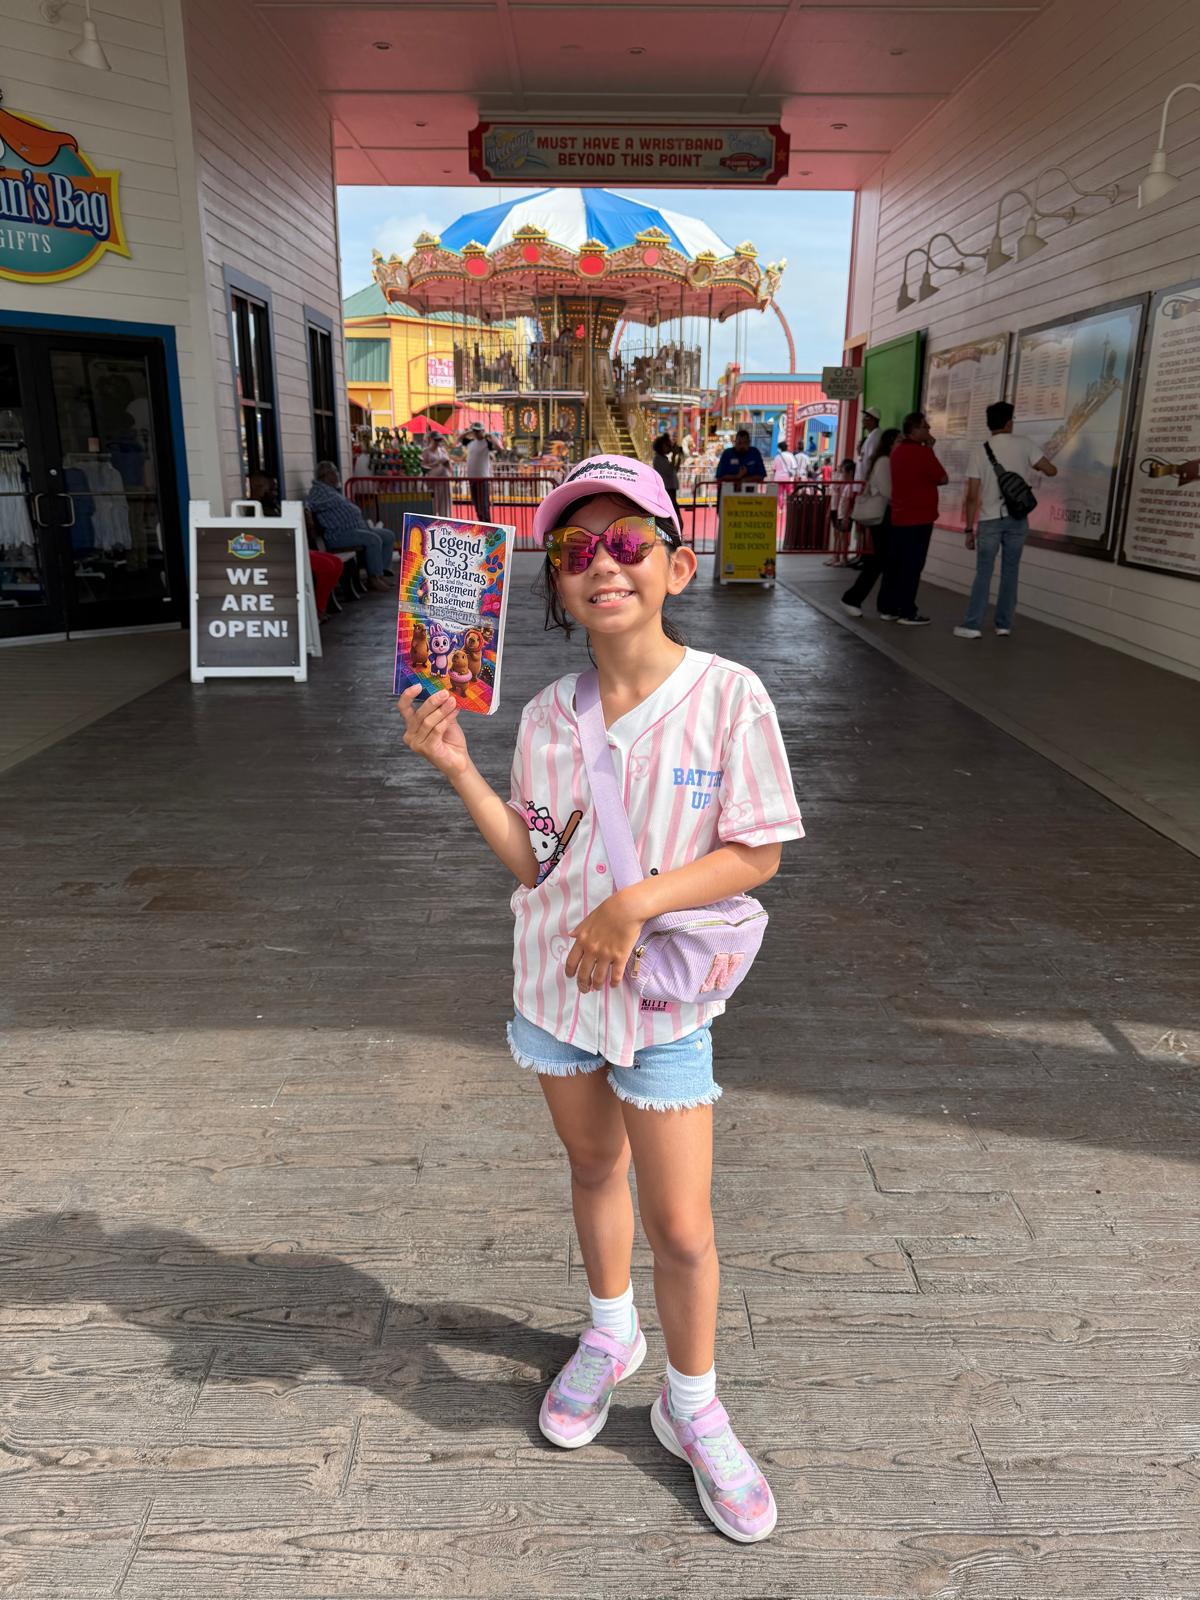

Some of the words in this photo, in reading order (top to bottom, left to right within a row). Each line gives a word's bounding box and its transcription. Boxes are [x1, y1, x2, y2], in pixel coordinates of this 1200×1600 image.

[536, 137, 577, 150] MUST
[583, 137, 620, 150] HAVE
[625, 137, 634, 150] A
[639, 138, 724, 151] WRISTBAND
[558, 153, 615, 167] BEYOND
[620, 154, 655, 167] THIS
[659, 154, 703, 168] POINT
[49, 173, 109, 238] Bag
[441, 527, 452, 536] The
[429, 529, 484, 557] Legend,
[445, 558, 456, 567] the
[458, 552, 469, 572] 3
[226, 567, 269, 586] WE
[424, 559, 486, 586] Capybaras
[430, 579, 477, 598] Basement
[221, 594, 275, 612] ARE
[430, 592, 475, 610] Basement
[429, 604, 477, 624] Basements
[208, 620, 288, 638] OPEN!
[699, 952, 745, 994] N
[641, 998, 669, 1008] KITTY
